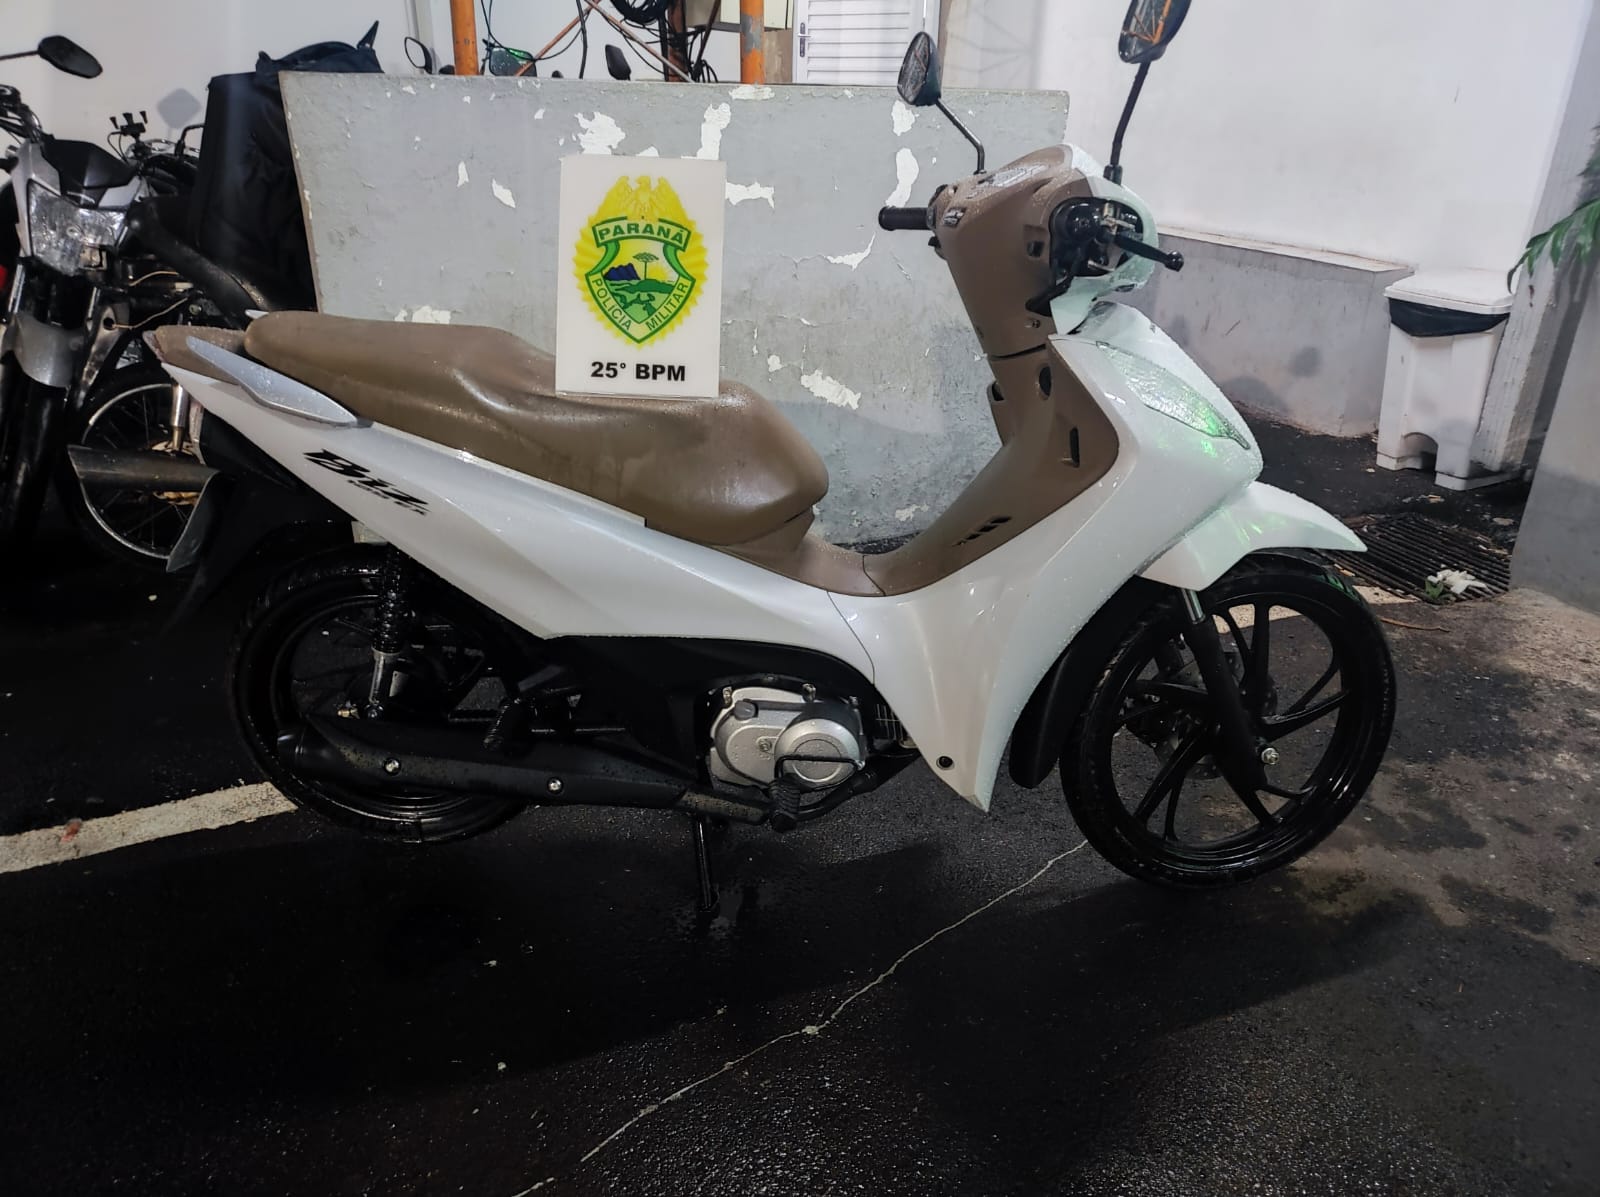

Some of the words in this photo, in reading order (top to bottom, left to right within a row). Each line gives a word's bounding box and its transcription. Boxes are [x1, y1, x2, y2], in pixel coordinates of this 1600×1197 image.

[598, 223, 684, 244] PARANÁ
[645, 282, 689, 331] MILITAR
[635, 363, 686, 382] BPM
[303, 448, 431, 513] Biz
